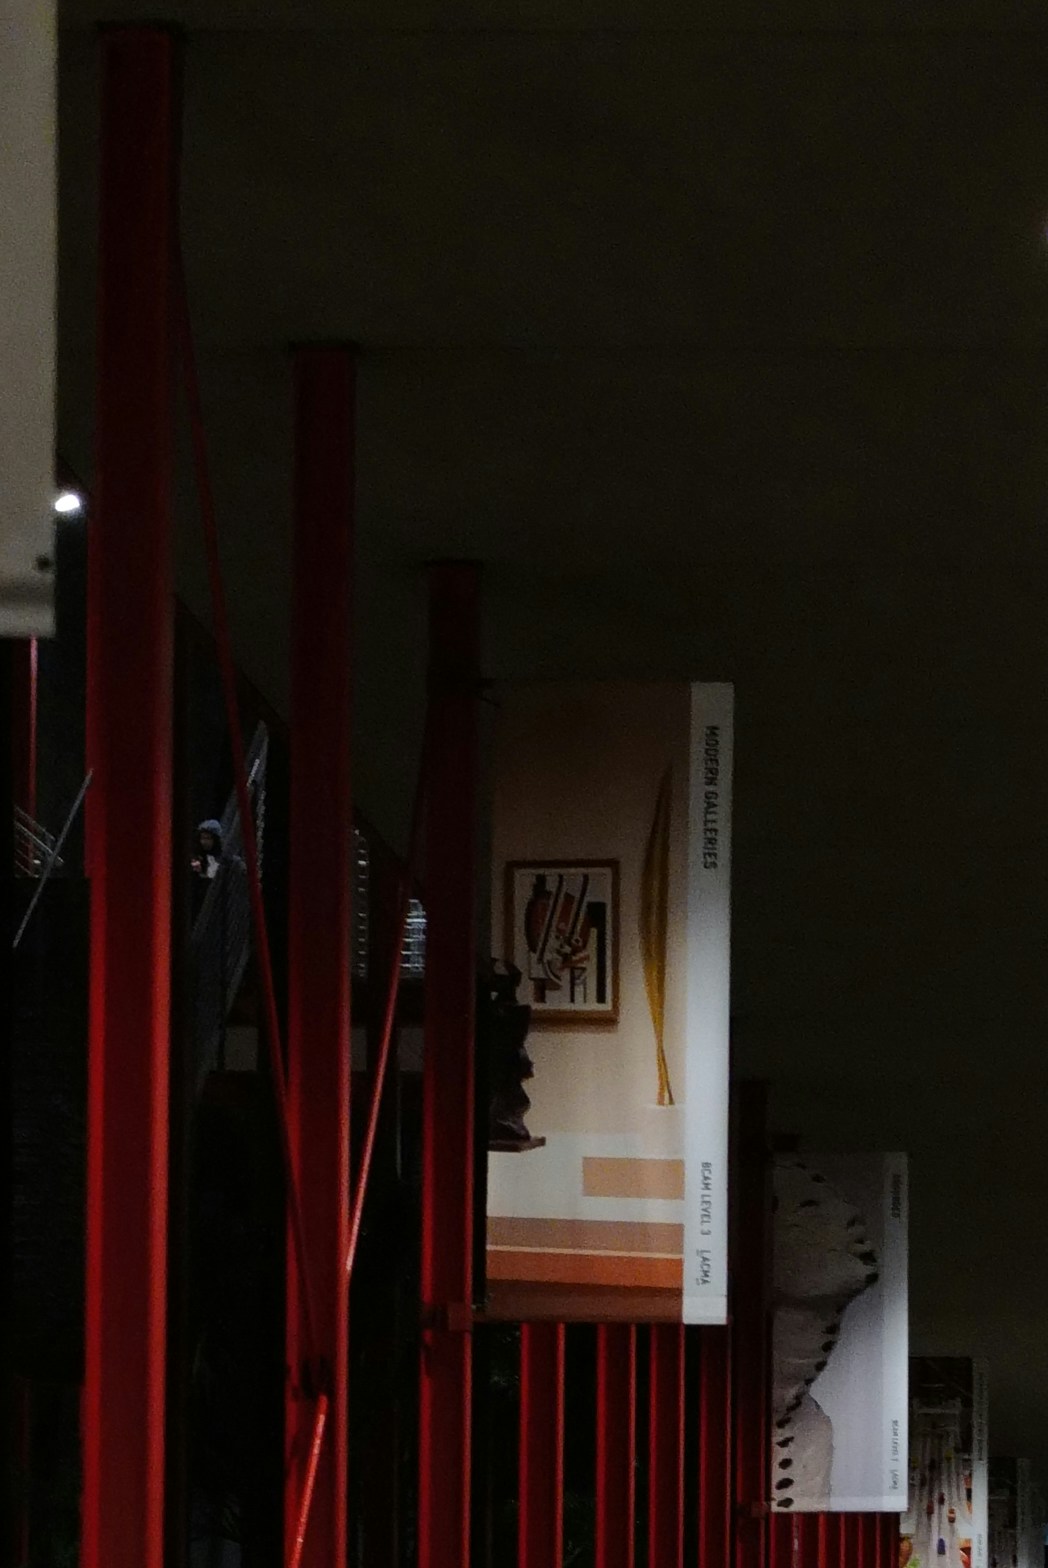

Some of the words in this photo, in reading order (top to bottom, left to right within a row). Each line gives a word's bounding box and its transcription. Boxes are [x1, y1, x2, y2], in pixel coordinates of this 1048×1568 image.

[704, 725, 720, 786] MODERN
[703, 790, 719, 869] GALLERIES
[700, 1161, 712, 1191] BCAM
[700, 1194, 712, 1224] LEVEL
[696, 1249, 711, 1286] LACMA
